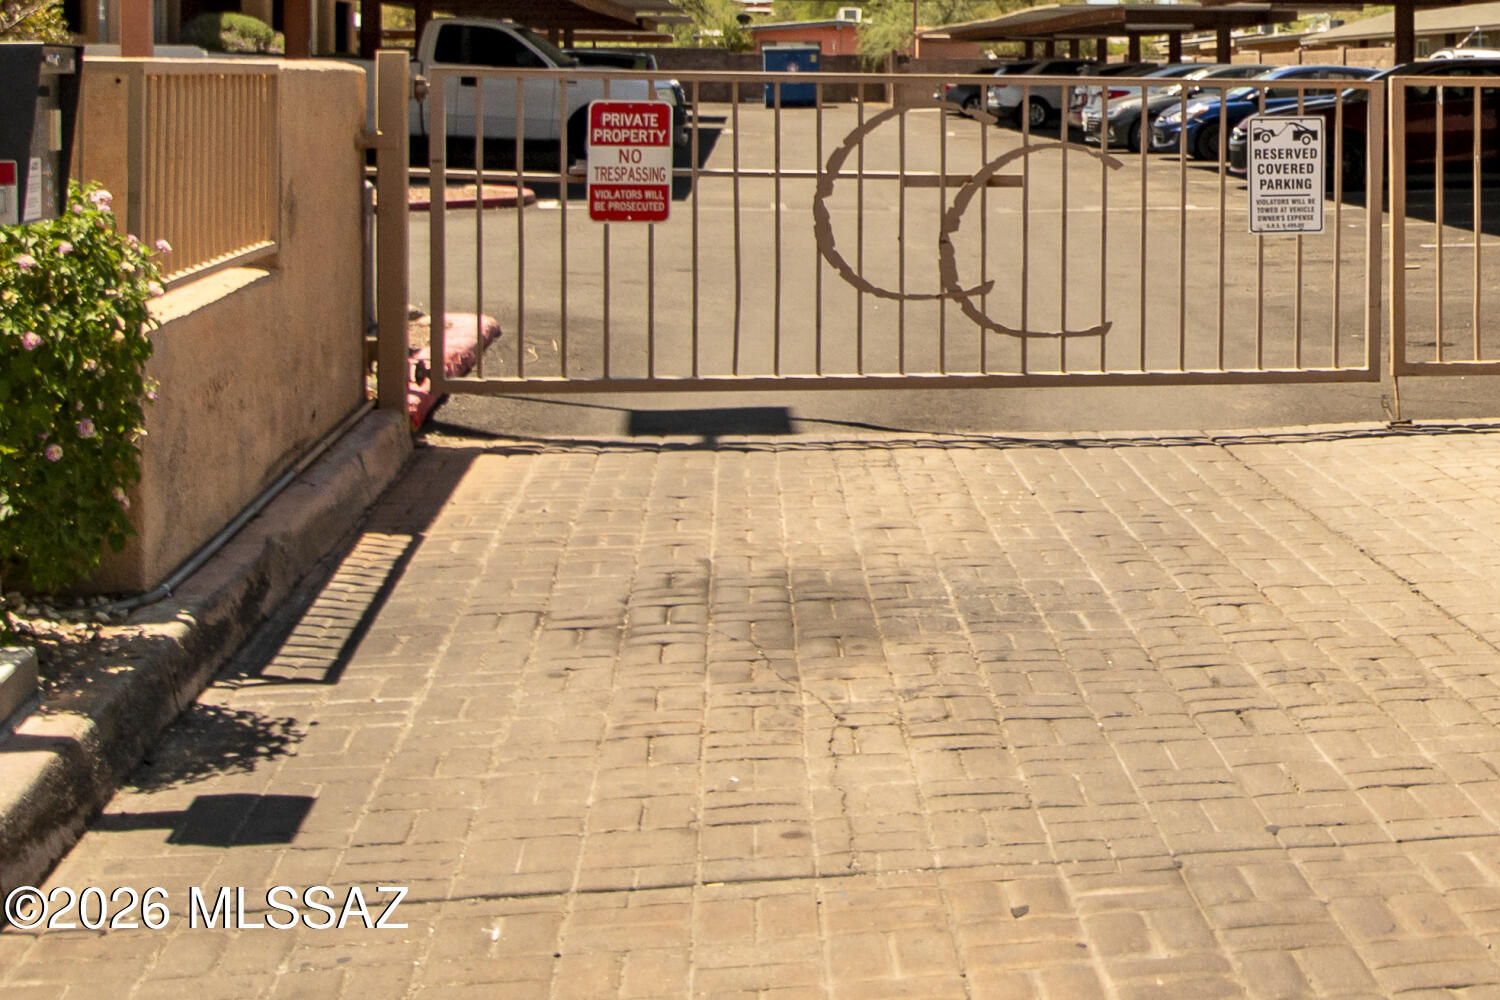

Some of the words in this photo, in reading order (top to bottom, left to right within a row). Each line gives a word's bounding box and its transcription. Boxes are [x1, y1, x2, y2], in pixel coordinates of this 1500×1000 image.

[602, 112, 659, 127] PRIVATE
[593, 128, 667, 143] PROPERTY
[618, 148, 642, 163] NO
[1254, 147, 1318, 160] RESERVED
[594, 166, 666, 182] TRESPASSING
[1257, 163, 1314, 175] COVERED
[1259, 178, 1312, 190] PARKING
[594, 189, 642, 200] VIOLATORS
[645, 189, 664, 200] WILL
[594, 201, 605, 212] BE
[607, 201, 665, 212] PROSECUTED
[1256, 198, 1289, 206] VIOLATORS
[1257, 206, 1278, 214] TOWED
[1289, 205, 1314, 213] VEHICLE
[1257, 214, 1285, 222] OWNER'S
